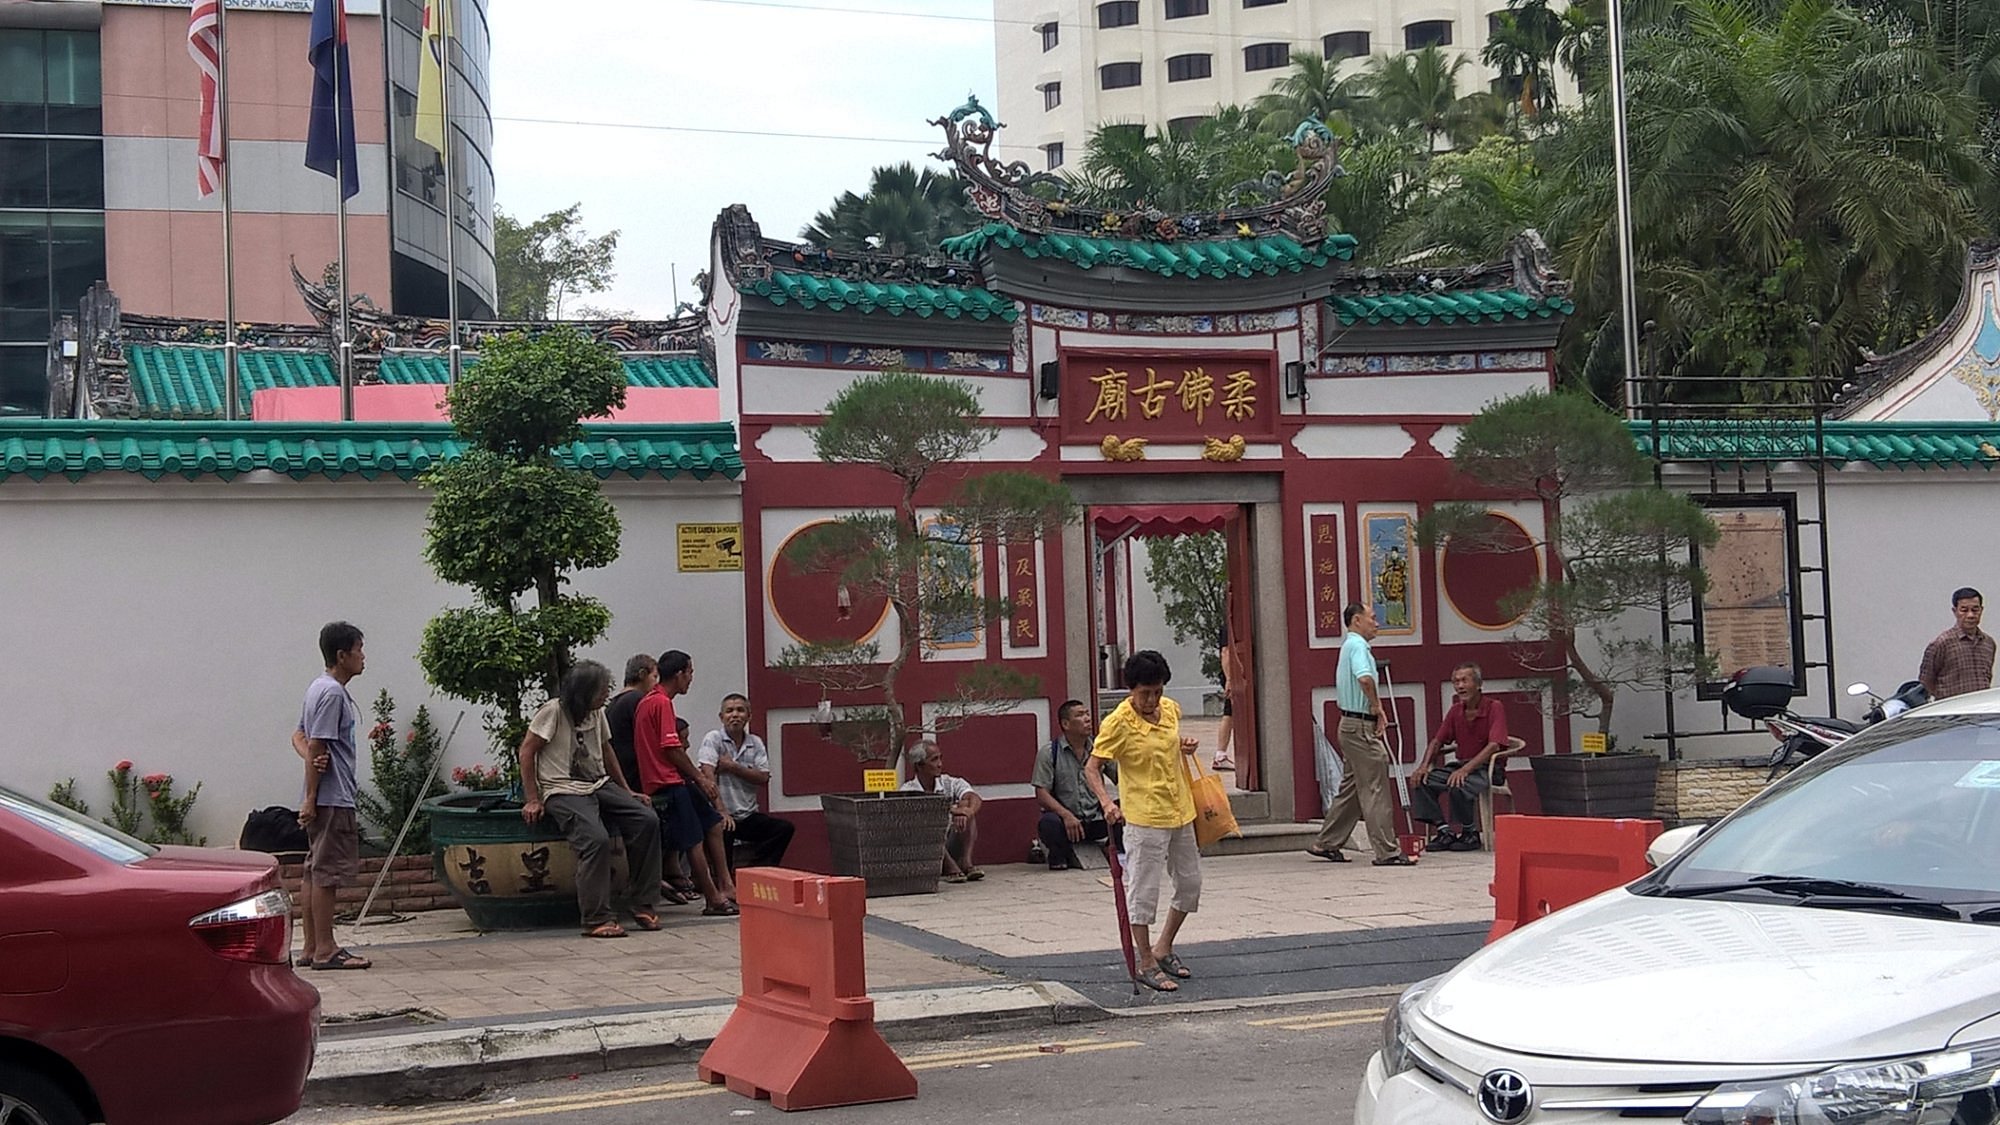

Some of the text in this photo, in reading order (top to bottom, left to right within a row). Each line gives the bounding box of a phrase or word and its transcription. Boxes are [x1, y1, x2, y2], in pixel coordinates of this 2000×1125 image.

[260, 0, 310, 10] MALAYSIA
[1085, 366, 1257, 426] 柔佛古廟
